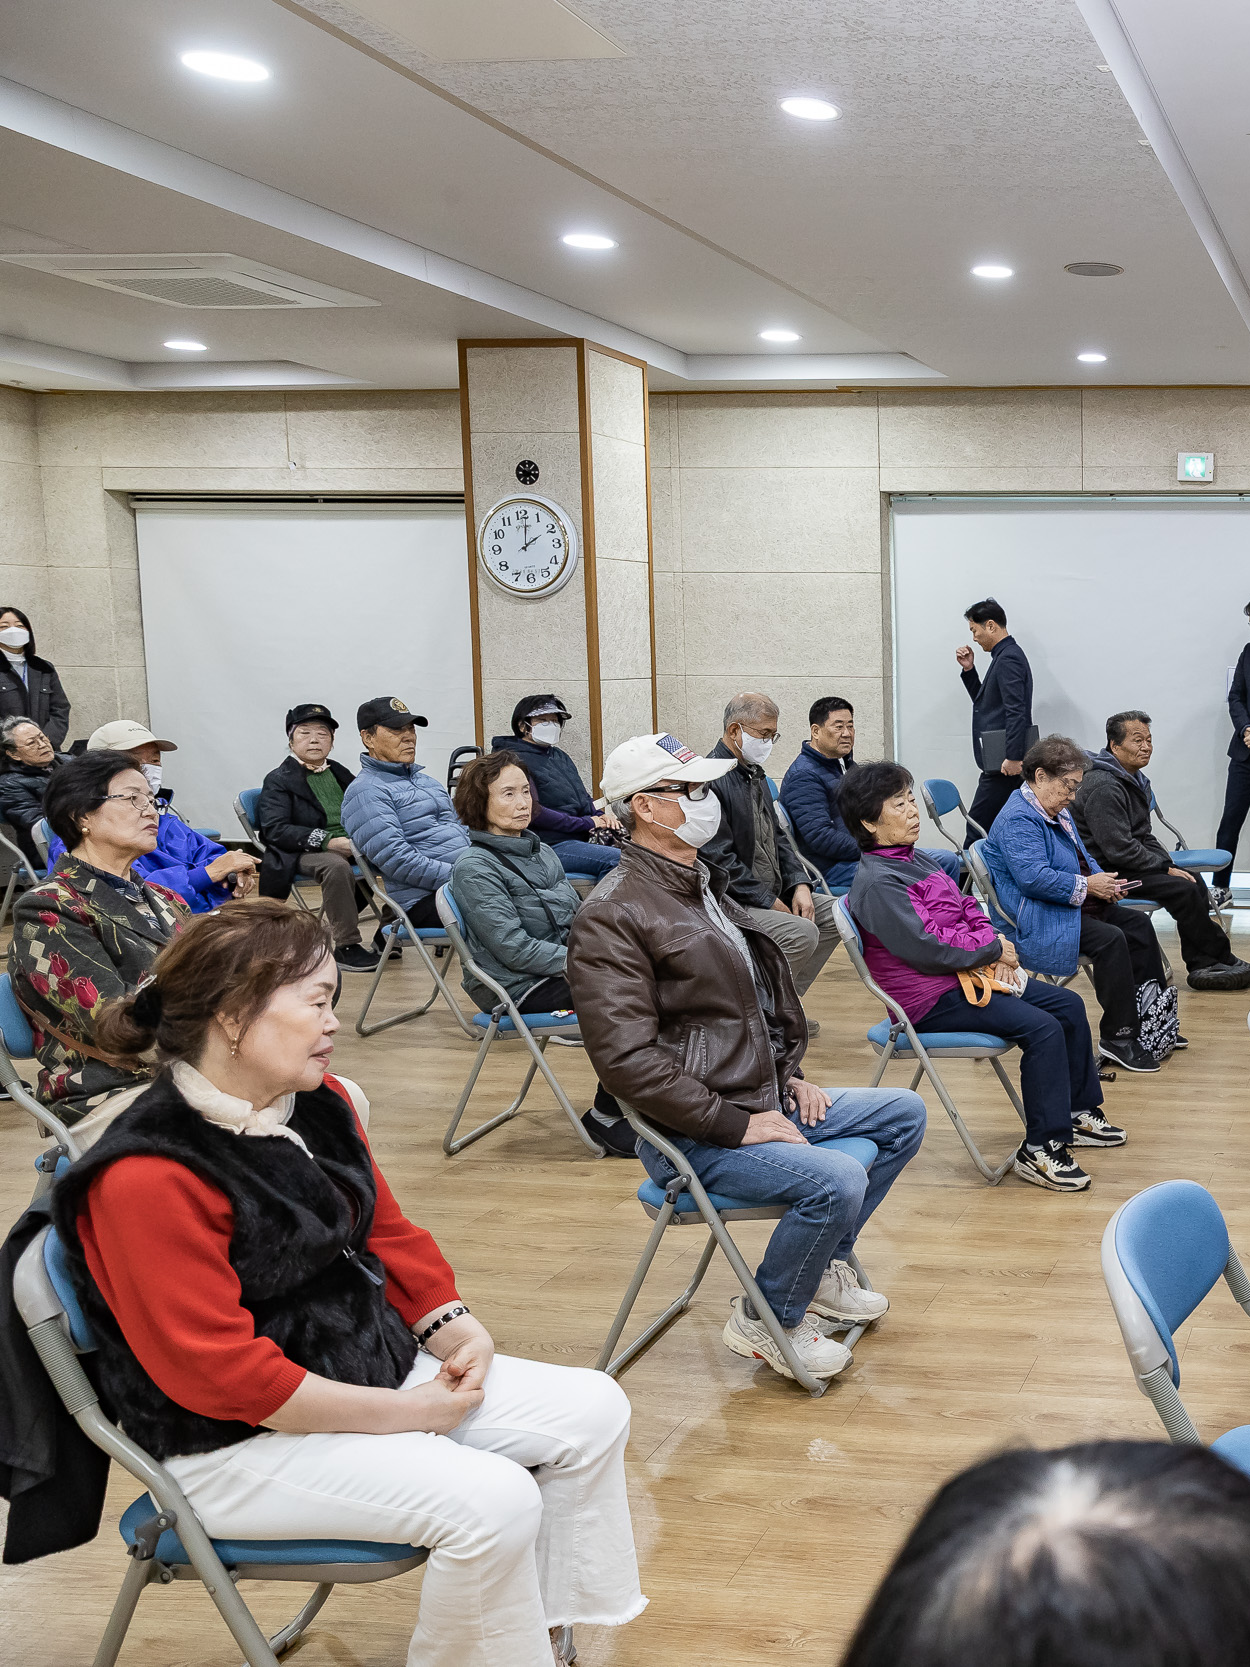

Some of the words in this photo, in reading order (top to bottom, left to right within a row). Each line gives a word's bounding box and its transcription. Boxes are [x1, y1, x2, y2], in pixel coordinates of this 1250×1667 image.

[515, 509, 529, 520] 12
[535, 512, 541, 523] 1
[501, 516, 512, 526] 11
[546, 523, 556, 534] 2
[493, 529, 505, 540] 10
[552, 538, 562, 549] 3
[491, 544, 502, 555] 9
[498, 560, 509, 571] 8
[549, 555, 559, 565] 4
[511, 571, 521, 582] 7
[526, 572, 536, 583] 6
[541, 566, 551, 578] 5
